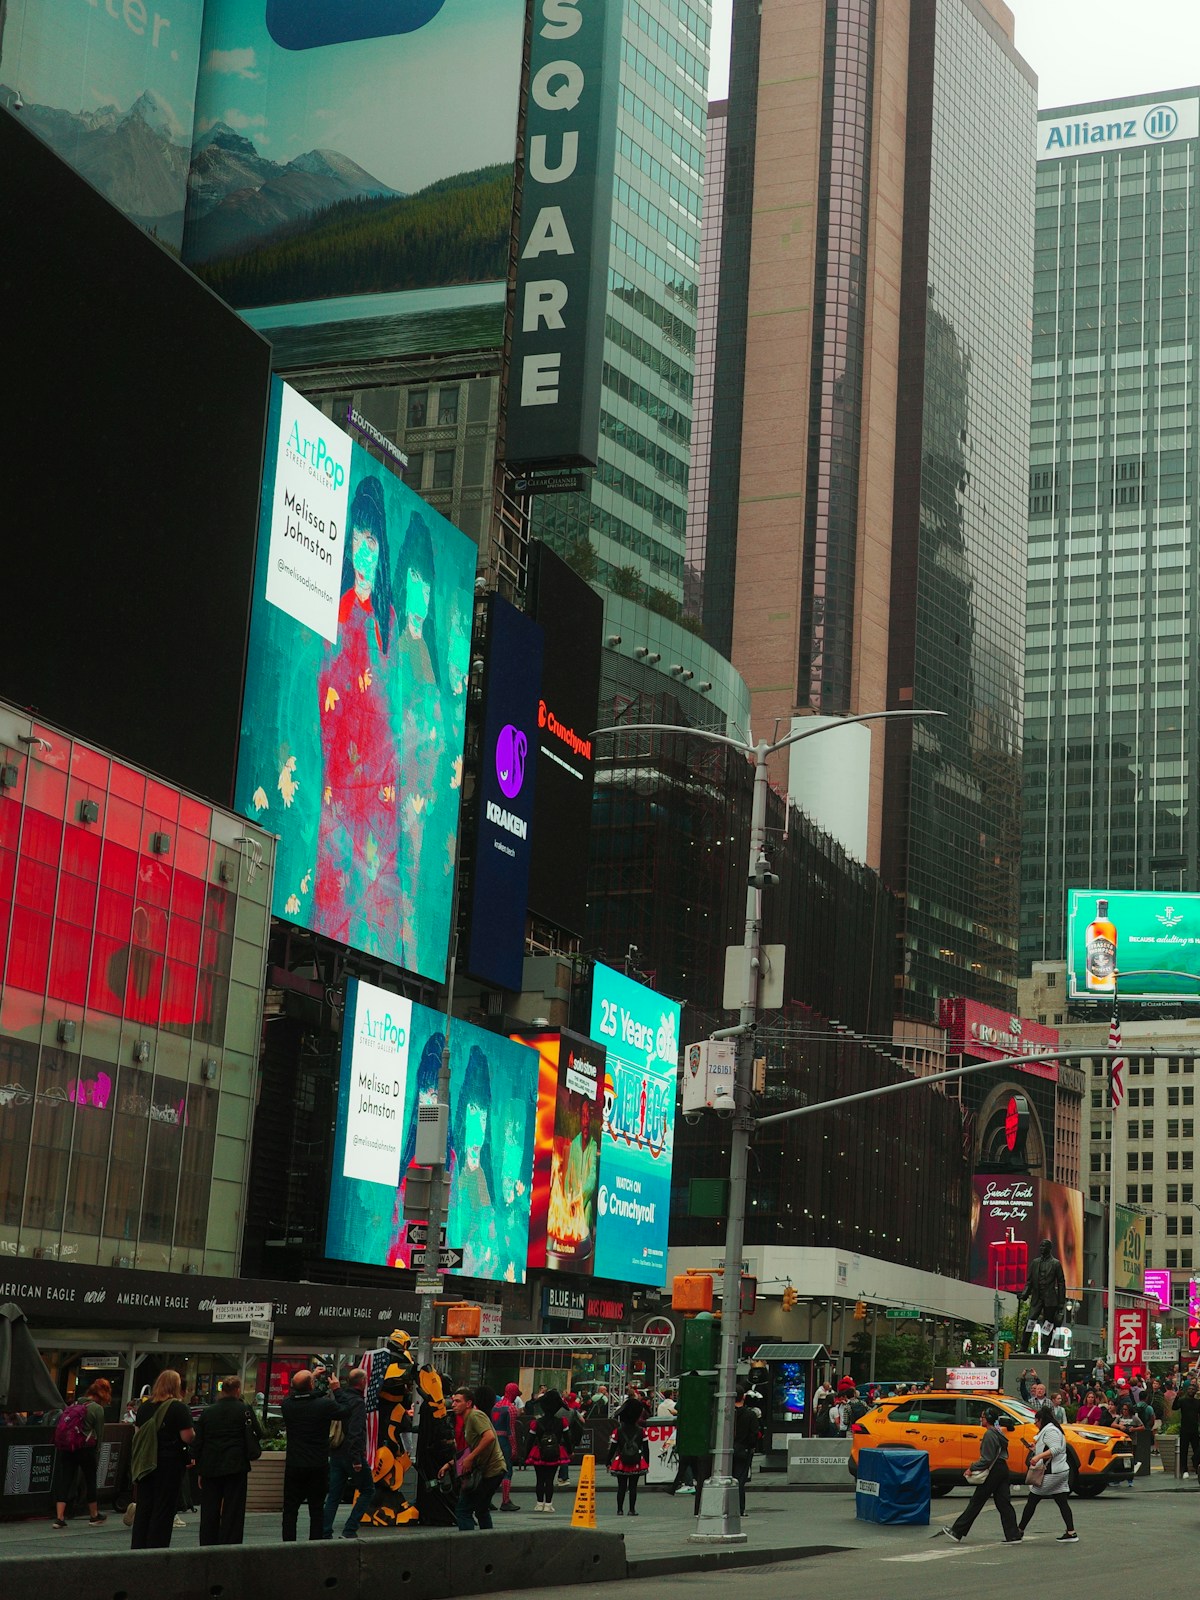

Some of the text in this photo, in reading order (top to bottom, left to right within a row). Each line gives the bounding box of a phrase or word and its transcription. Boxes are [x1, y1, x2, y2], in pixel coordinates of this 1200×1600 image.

[1045, 120, 1137, 150] Allianz
[520, 0, 586, 407] SQUARE
[286, 419, 345, 491] ArtPop
[350, 409, 409, 467] #OUTFRONTPRIME
[285, 448, 333, 490] STREET GALLERY
[284, 485, 338, 541] Melissa D
[284, 515, 332, 566] Johnston
[277, 558, 333, 602] @melissadjohnston
[547, 712, 592, 760] Crunchyroll
[486, 800, 528, 841] KRAKEN
[1156, 934, 1188, 946] adulting
[361, 1008, 406, 1053] ArtPop
[600, 999, 618, 1037] 25
[620, 1007, 654, 1053] Years
[358, 1071, 400, 1098] Melissa D
[358, 1093, 396, 1120] Johnston
[352, 1134, 396, 1153] @melissadjohnston
[615, 1175, 642, 1193] WATCH ON
[983, 1181, 1033, 1200] Sweet Tooth
[609, 1192, 655, 1225] Crunchyroll
[1123, 1227, 1141, 1261] 120
[0, 1283, 42, 1298] MERICAN
[46, 1286, 76, 1301] EAGLE
[83, 1287, 107, 1303] aerie
[117, 1293, 161, 1306] AMERICAN
[164, 1296, 189, 1309] EAGLE
[198, 1296, 217, 1311] aeri
[295, 1303, 312, 1317] aerie
[319, 1306, 351, 1318] AMERICAN
[353, 1308, 372, 1319] EAGLE
[377, 1307, 393, 1320] aerie
[399, 1312, 420, 1323] AMERIC
[549, 1288, 569, 1307] BLUE
[1119, 1313, 1142, 1363] tkts
[32, 1465, 51, 1476] SQUARE
[36, 1455, 52, 1464] TIMES
